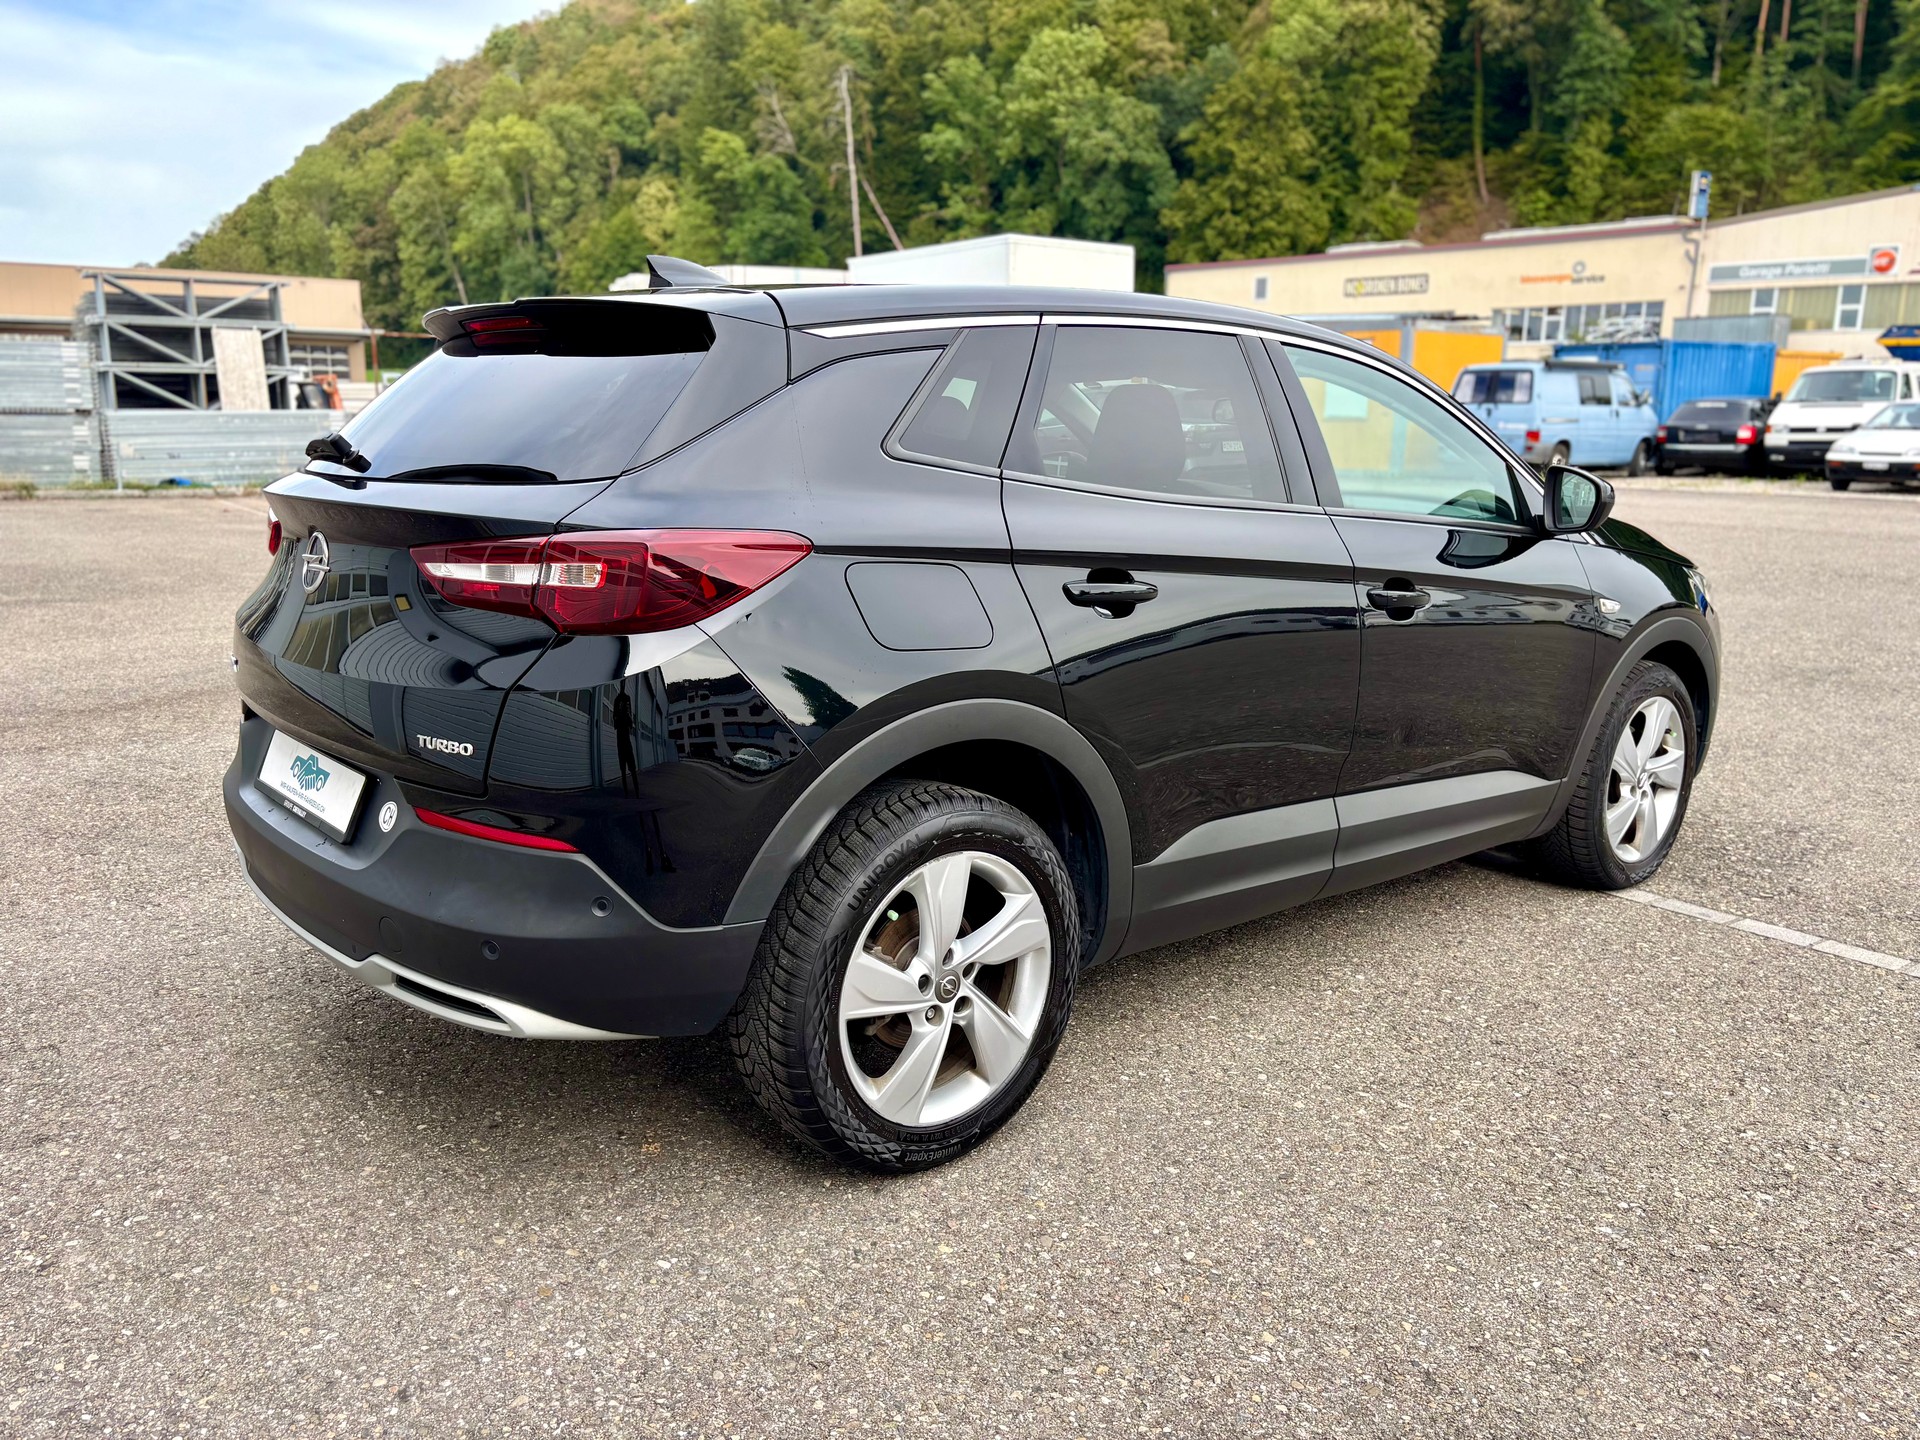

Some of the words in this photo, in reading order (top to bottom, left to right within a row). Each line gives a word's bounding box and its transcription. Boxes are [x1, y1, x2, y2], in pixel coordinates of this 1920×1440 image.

[1739, 265, 1782, 279] Garage
[416, 734, 474, 756] TURBO
[382, 805, 397, 828] CH
[846, 832, 928, 912] UNIROYAL
[904, 1143, 962, 1163] WinterExpert
